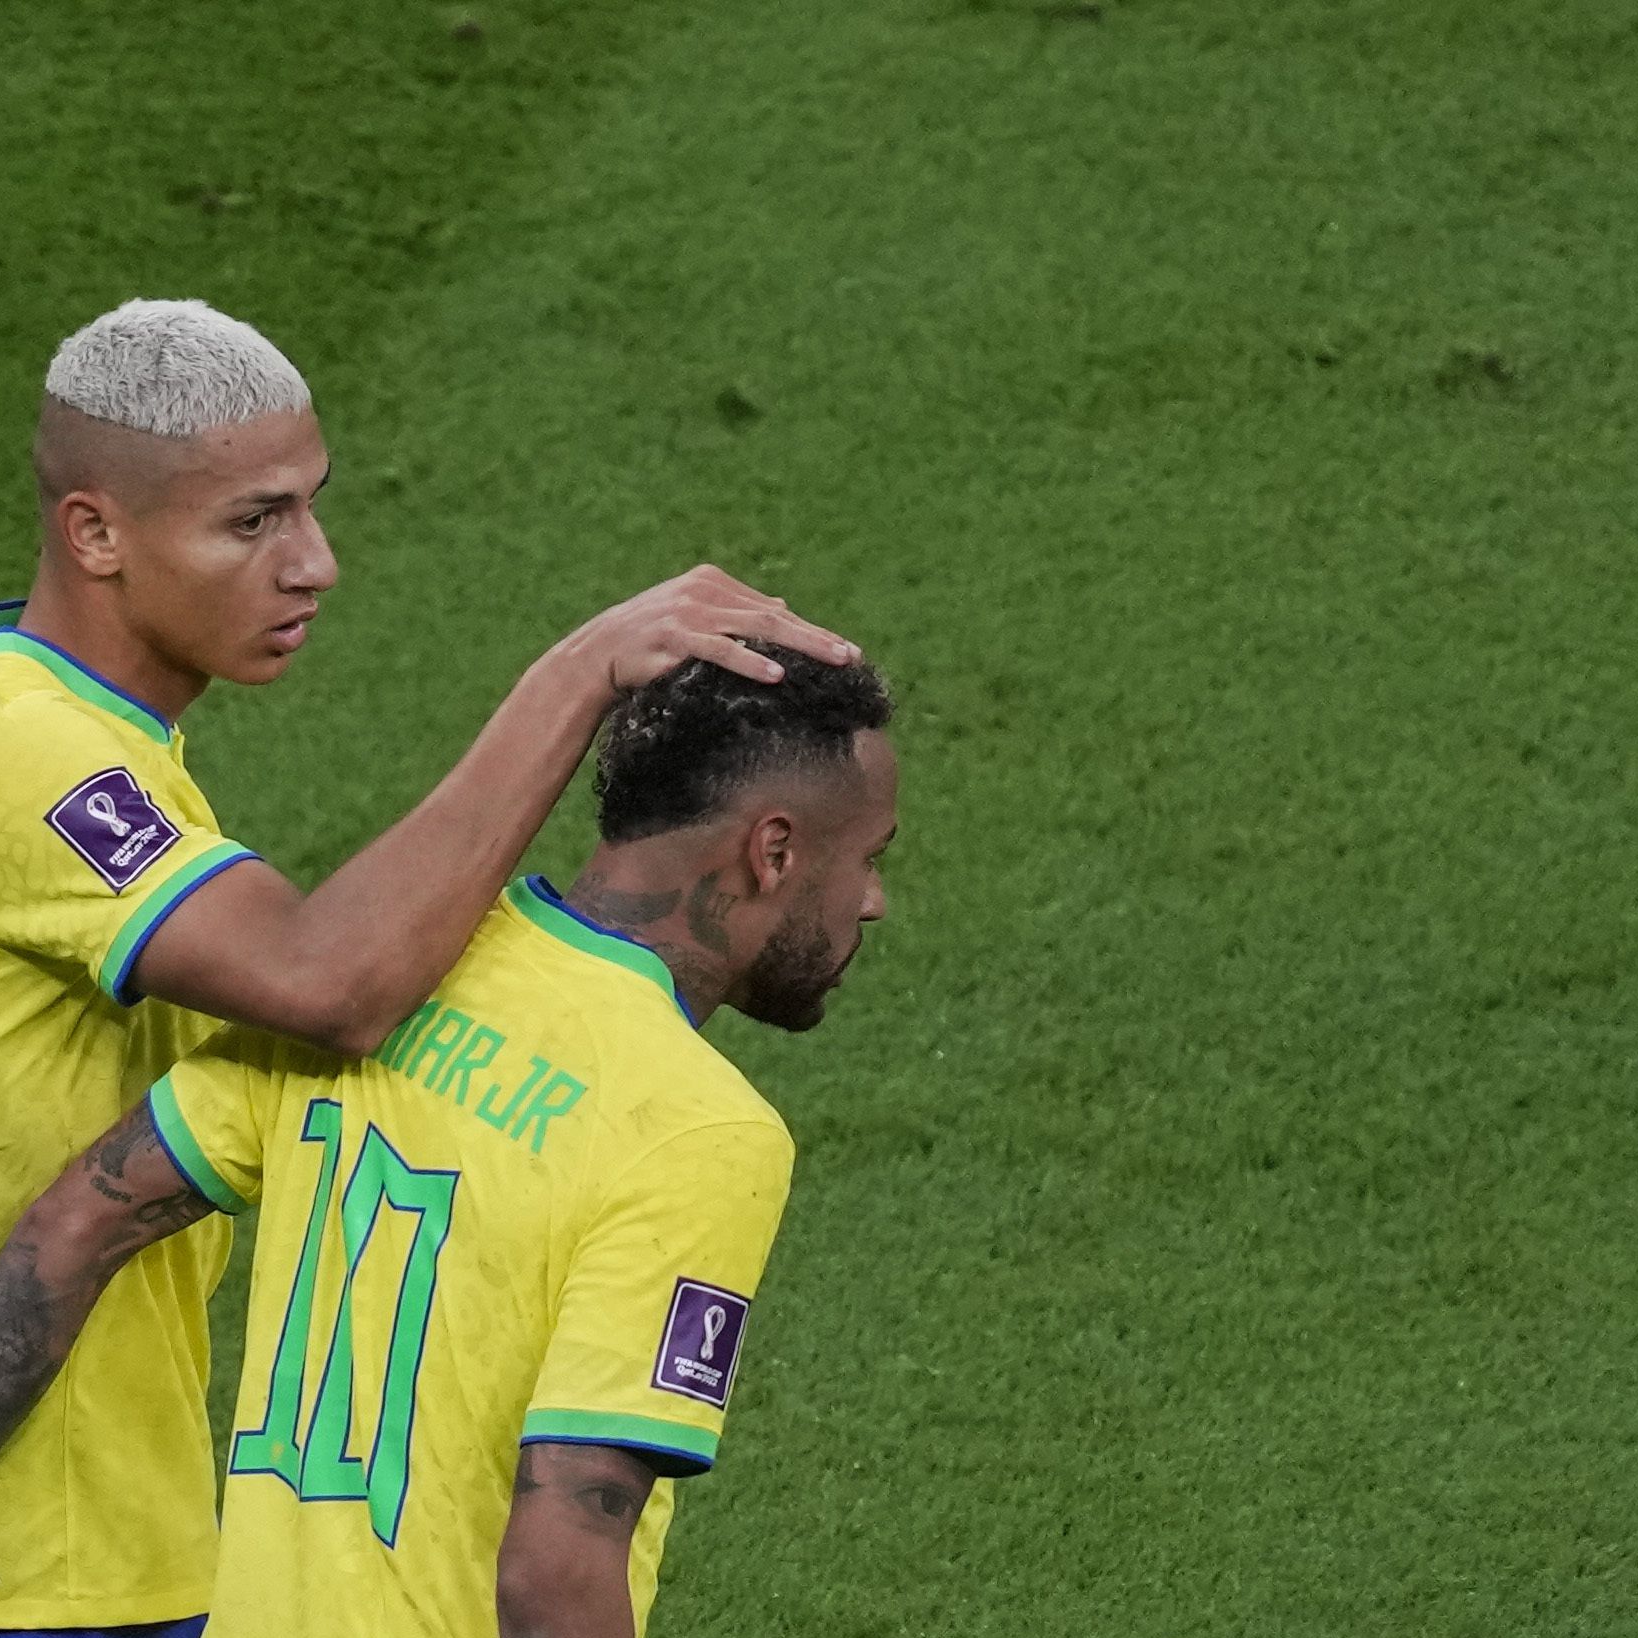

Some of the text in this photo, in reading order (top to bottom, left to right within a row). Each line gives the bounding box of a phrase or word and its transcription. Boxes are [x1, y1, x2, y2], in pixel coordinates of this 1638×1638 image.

[117, 841, 143, 867] Qatar
[475, 1055, 588, 1154] JR
[228, 1098, 461, 1551] 10
